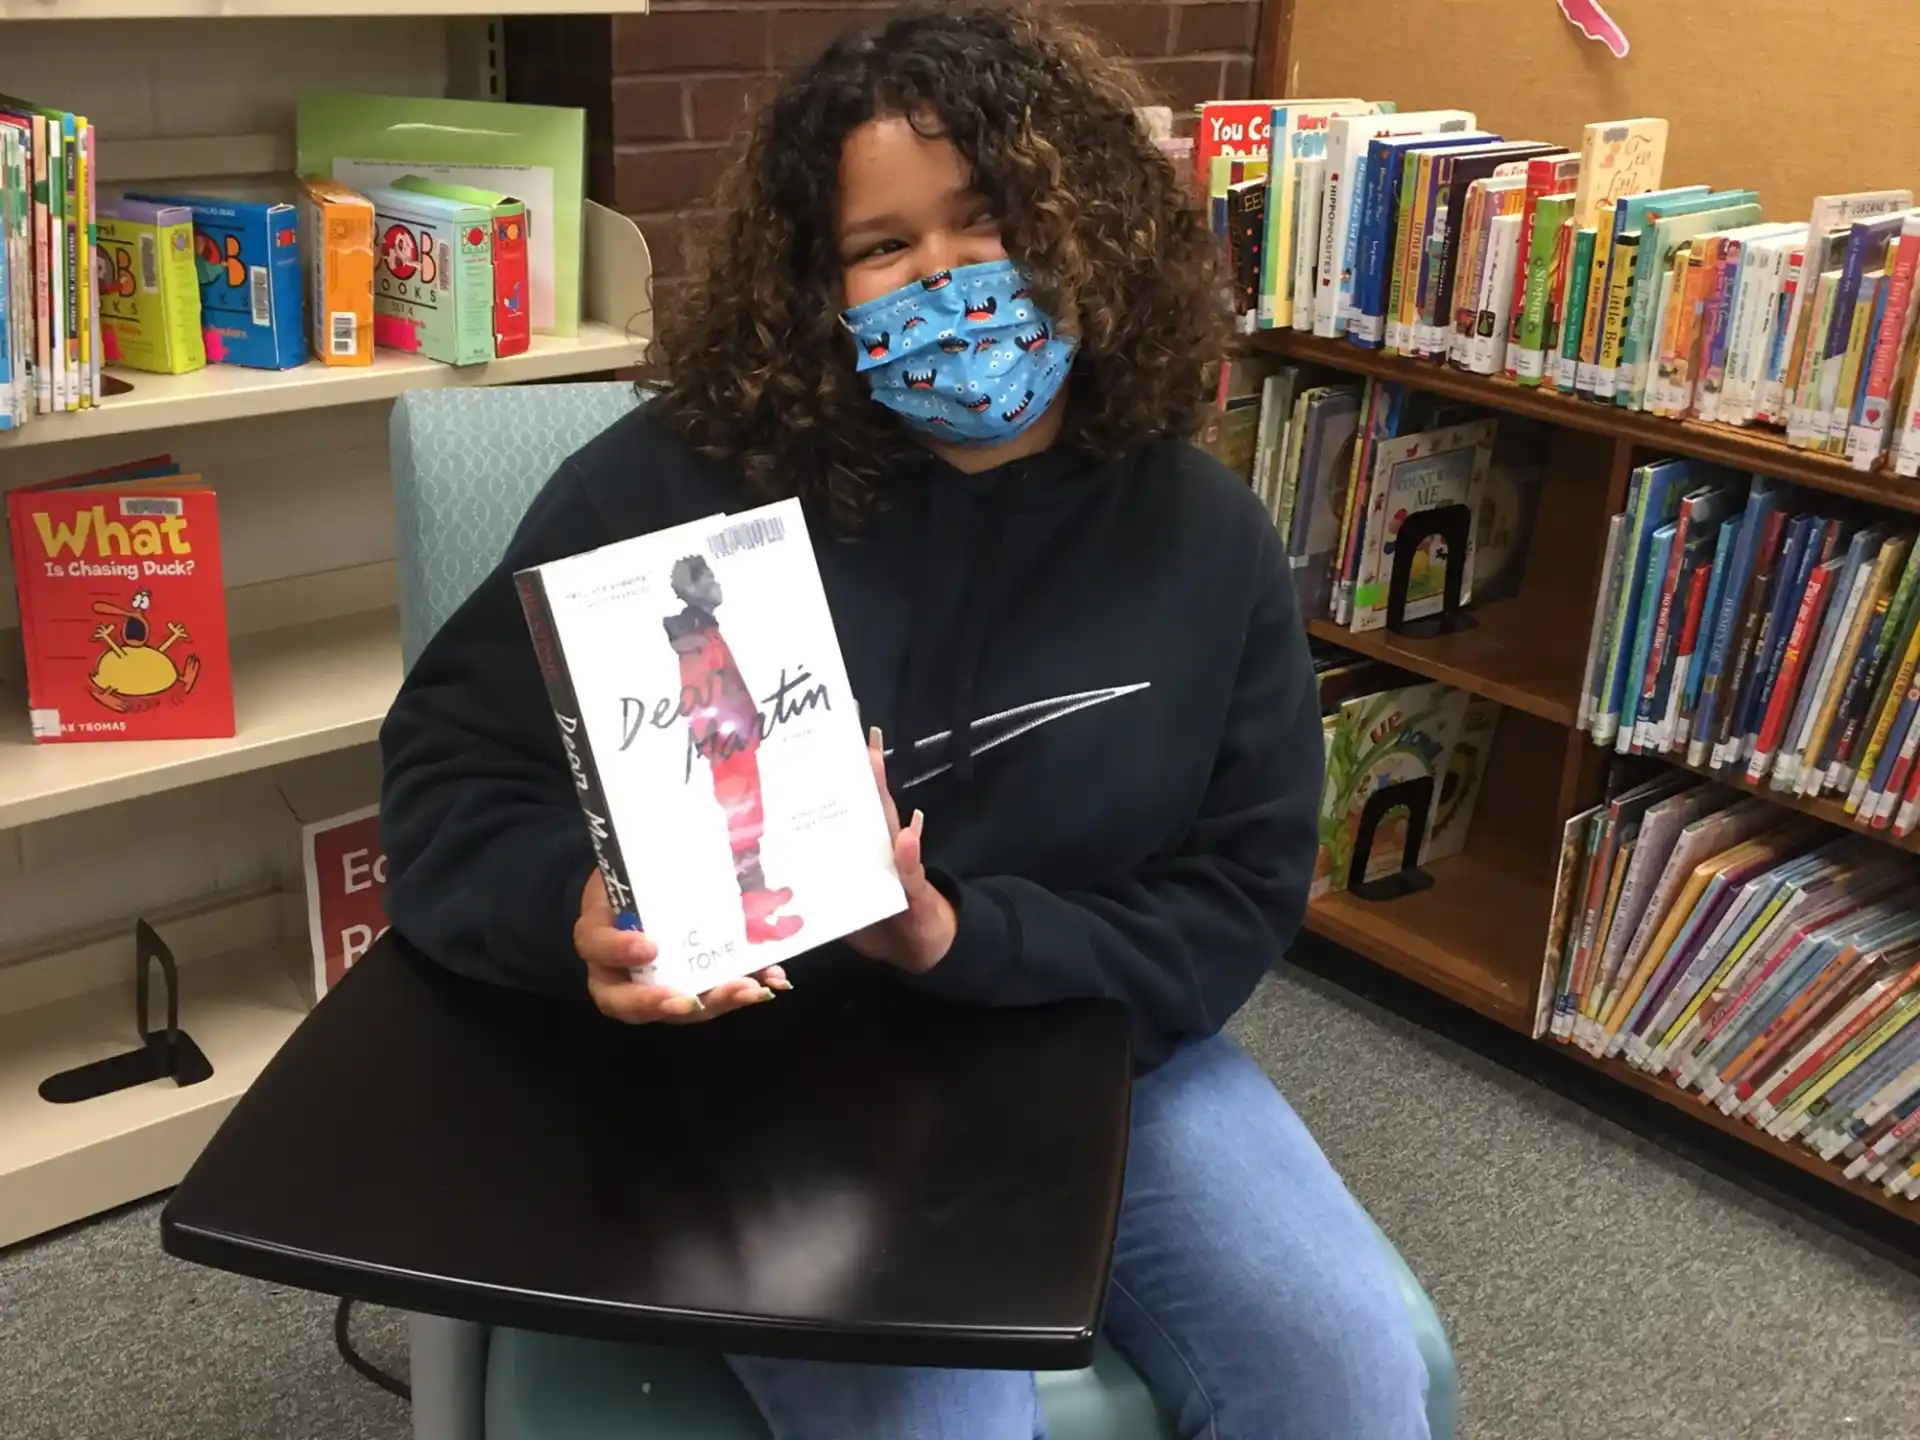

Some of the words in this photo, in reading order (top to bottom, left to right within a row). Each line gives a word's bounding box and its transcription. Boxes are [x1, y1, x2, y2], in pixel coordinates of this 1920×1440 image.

[1210, 118, 1244, 142] You
[1248, 116, 1270, 141] Ca
[1322, 184, 1339, 274] HIPPOPPOSITES
[381, 277, 438, 304] OOKS
[1606, 284, 1624, 327] Little
[1602, 330, 1617, 359] Bee
[1413, 485, 1442, 508] ME
[32, 505, 191, 558] What
[44, 561, 64, 578] Is
[67, 558, 140, 581] Chasing
[143, 560, 196, 578] Duck?
[1657, 606, 1668, 626] two
[1653, 626, 1666, 649] alike
[618, 667, 736, 752] Dear
[79, 723, 127, 734] THOMAS
[685, 664, 832, 786] Martin
[554, 708, 589, 801] Dear
[584, 807, 631, 915] Martin
